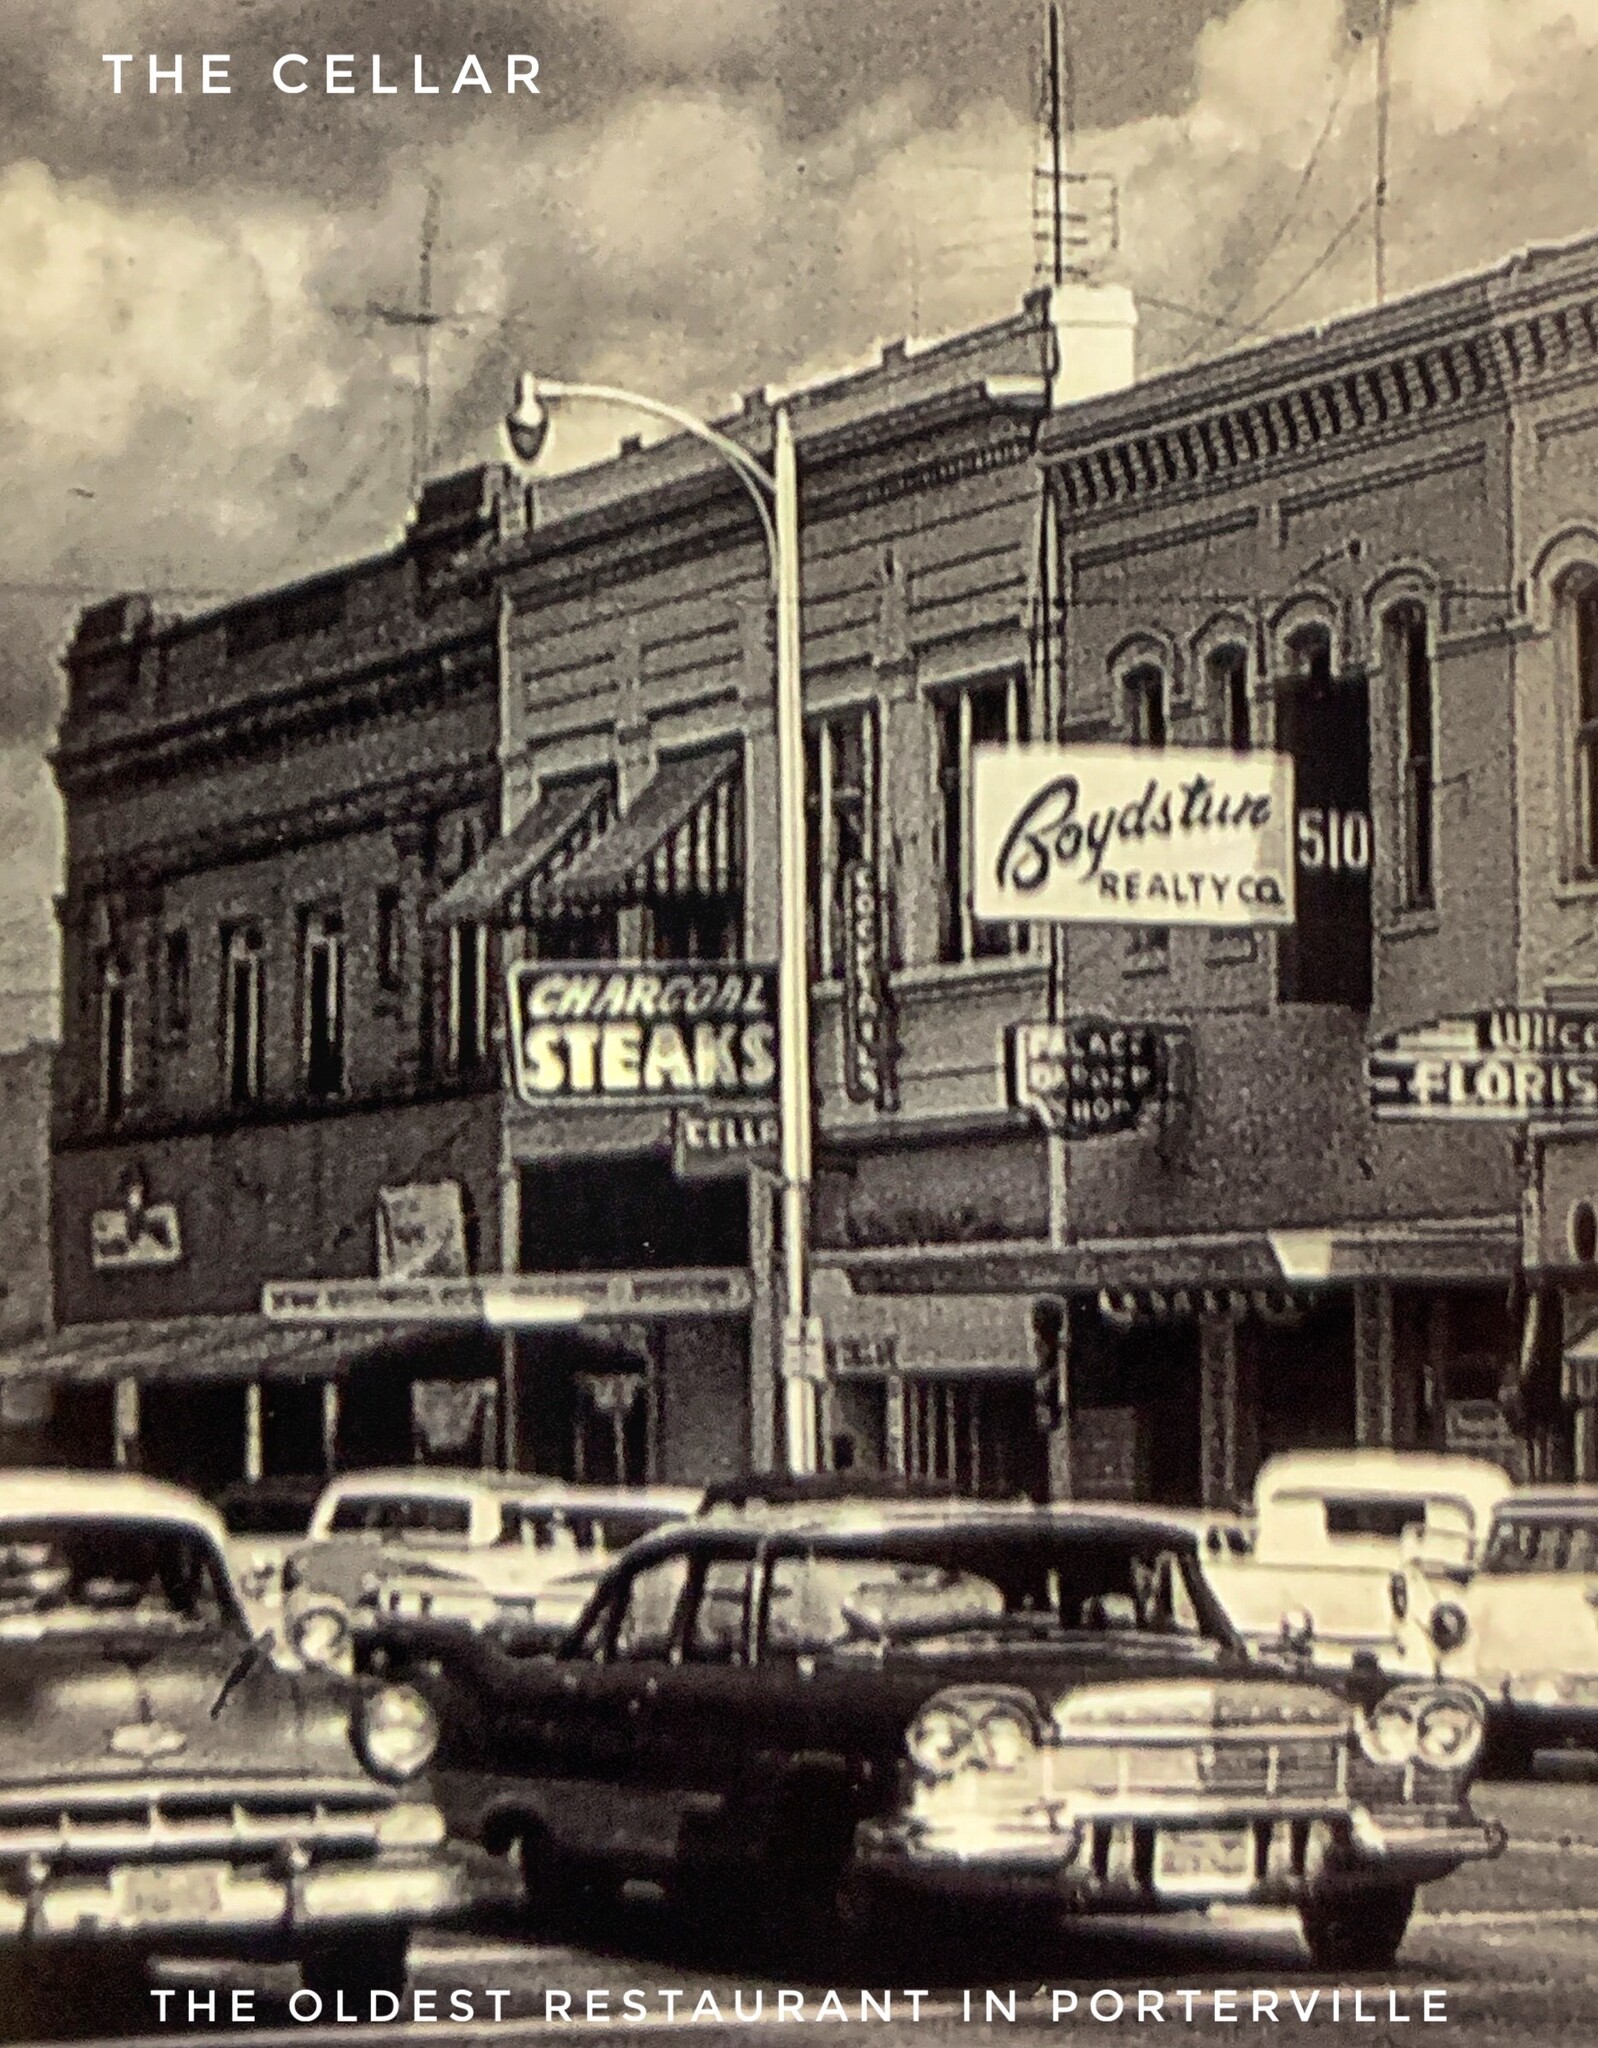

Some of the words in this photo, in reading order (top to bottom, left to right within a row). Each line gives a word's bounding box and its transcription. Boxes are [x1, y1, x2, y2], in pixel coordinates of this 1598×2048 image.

[995, 774, 1273, 891] Boydstun
[1299, 808, 1370, 872] 510
[1099, 872, 1230, 905] REALTY
[528, 972, 768, 1018] CHARCOAL
[523, 1021, 777, 1091] STEAKS
